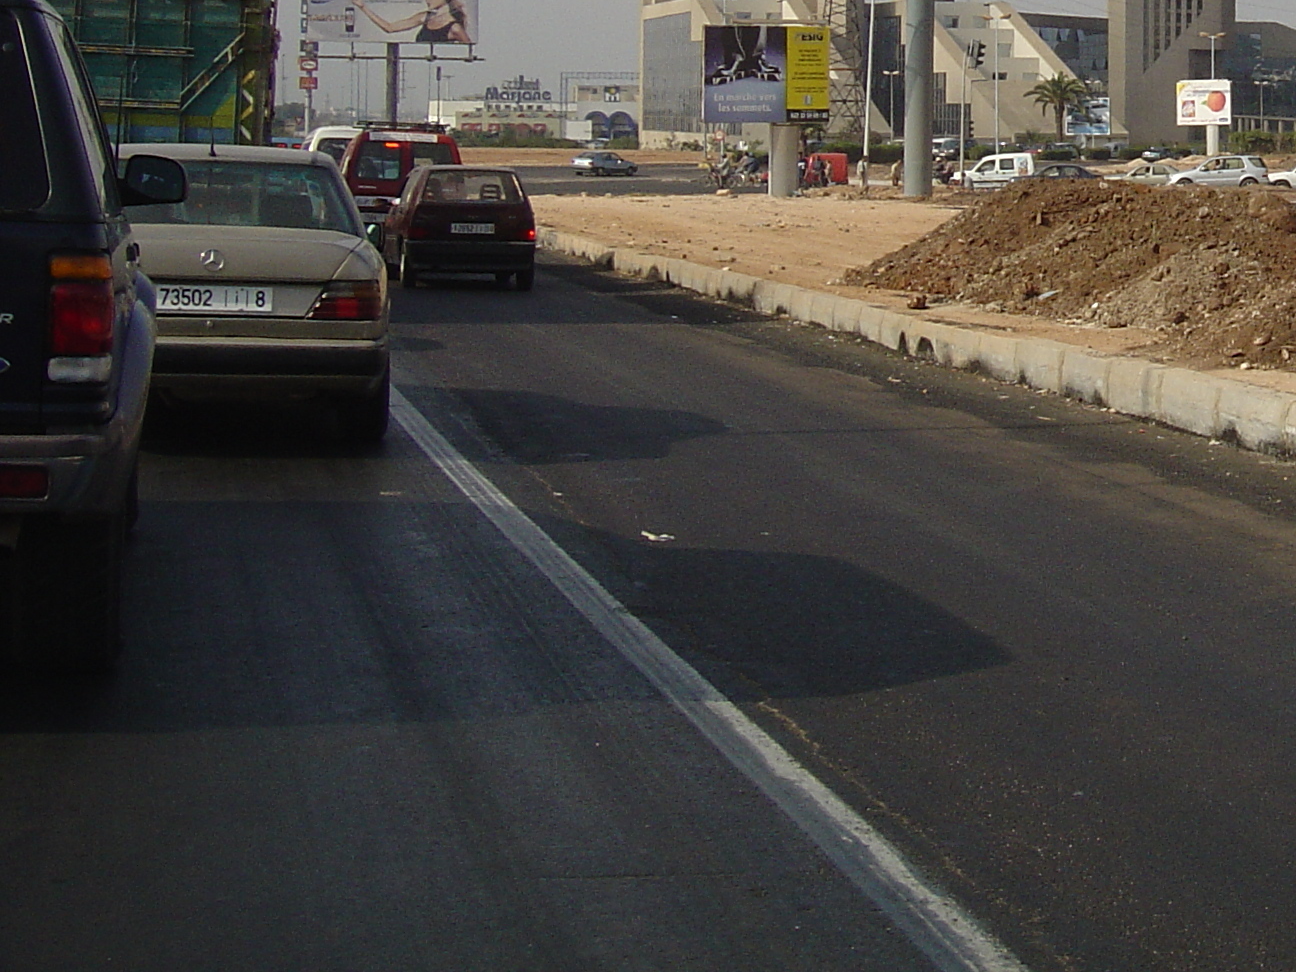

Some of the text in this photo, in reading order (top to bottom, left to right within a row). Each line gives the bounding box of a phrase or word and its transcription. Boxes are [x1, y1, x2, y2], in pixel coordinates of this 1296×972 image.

[485, 86, 552, 104] Marjane
[713, 92, 777, 102] En marche vers
[718, 103, 730, 112] les
[160, 288, 213, 307] 73502
[255, 290, 266, 308] 8
